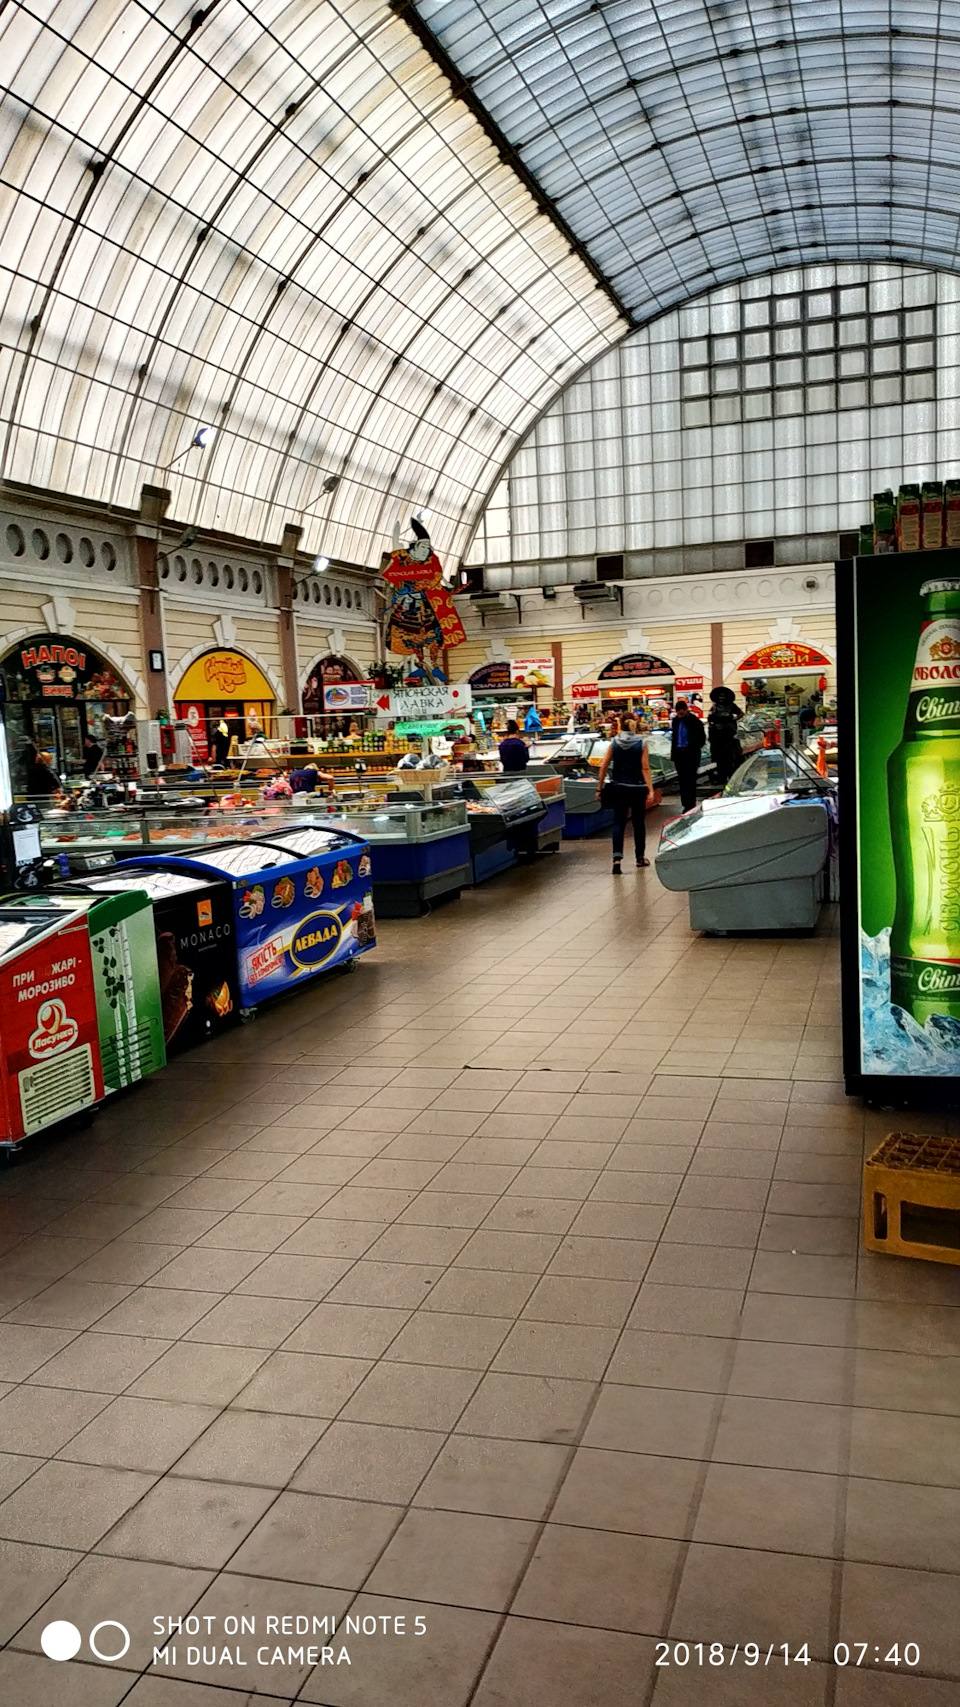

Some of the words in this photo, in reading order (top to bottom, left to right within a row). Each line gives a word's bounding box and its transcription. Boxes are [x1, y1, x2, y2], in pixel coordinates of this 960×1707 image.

[393, 687, 449, 699] ЯПОНСКАЯ
[400, 698, 444, 710] ЛАВКА
[180, 923, 231, 950] MONACO
[294, 924, 338, 953] ЛЕВАДА
[251, 942, 277, 971] ЯКІСТЬ
[12, 970, 35, 987] ПРИ
[51, 957, 76, 975] ЖАРІ
[17, 973, 76, 1002] МОРОЗИВО
